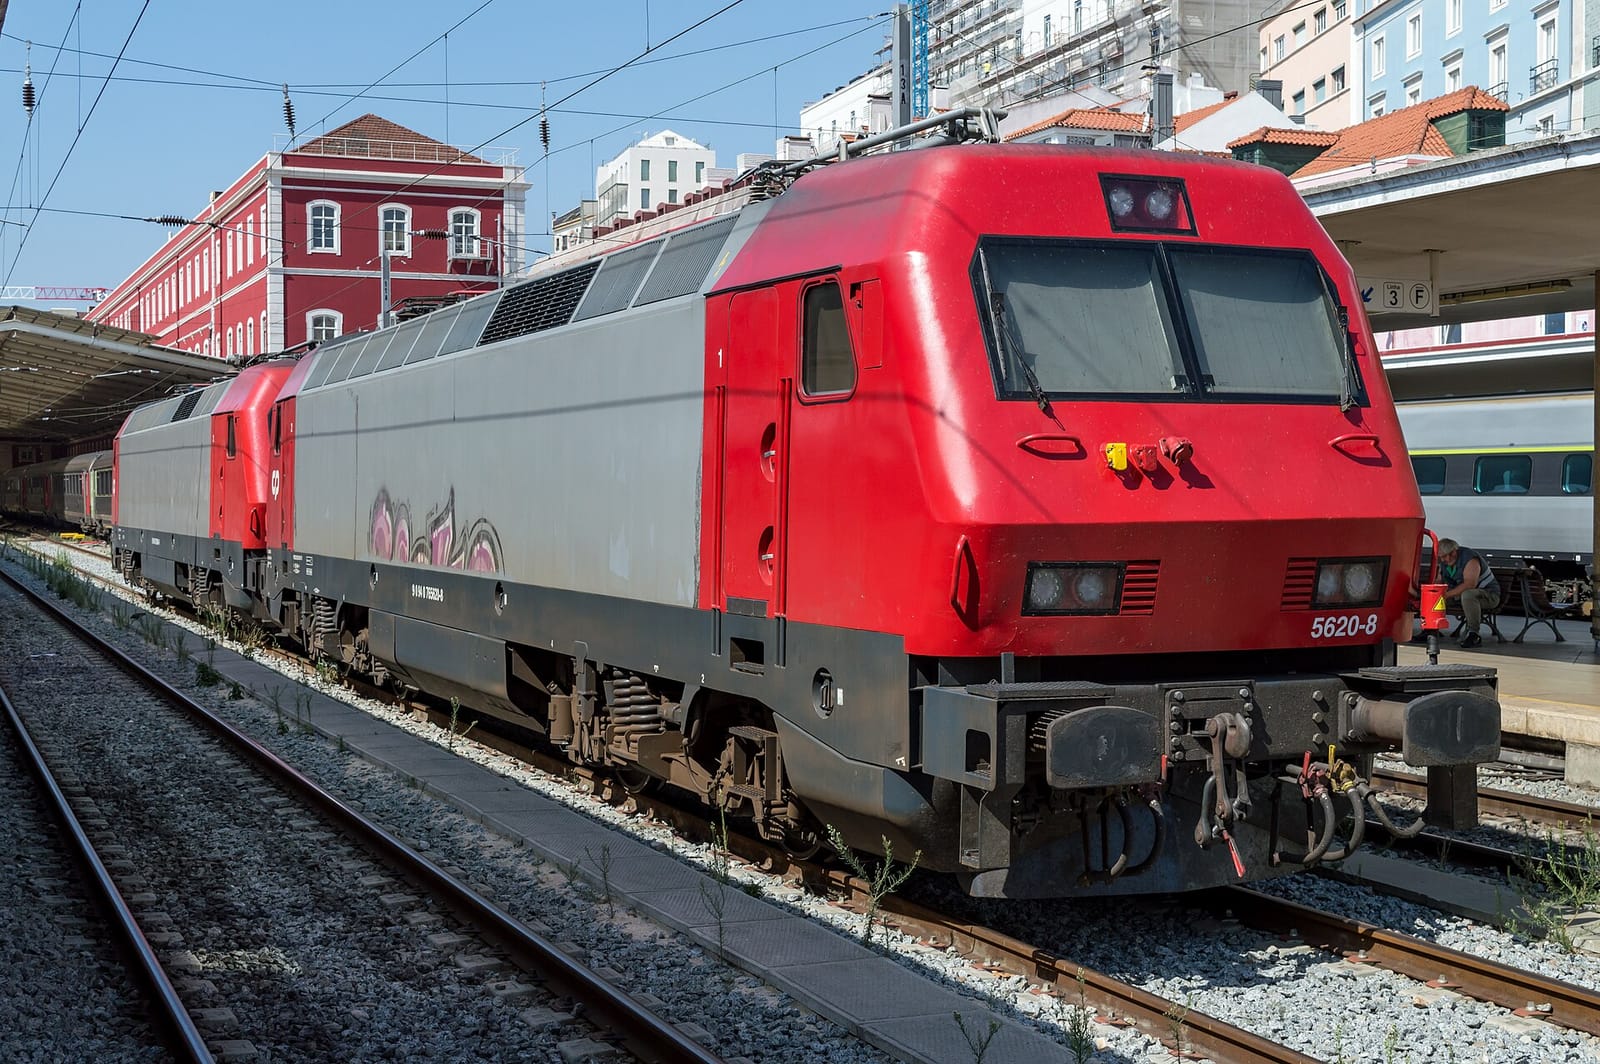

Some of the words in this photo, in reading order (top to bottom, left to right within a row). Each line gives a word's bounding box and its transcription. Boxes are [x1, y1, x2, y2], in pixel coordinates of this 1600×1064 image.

[1389, 290, 1398, 306] 3
[1415, 289, 1424, 304] F
[717, 348, 723, 368] 1
[1311, 614, 1378, 639] 5620-8
[700, 673, 705, 684] 2
